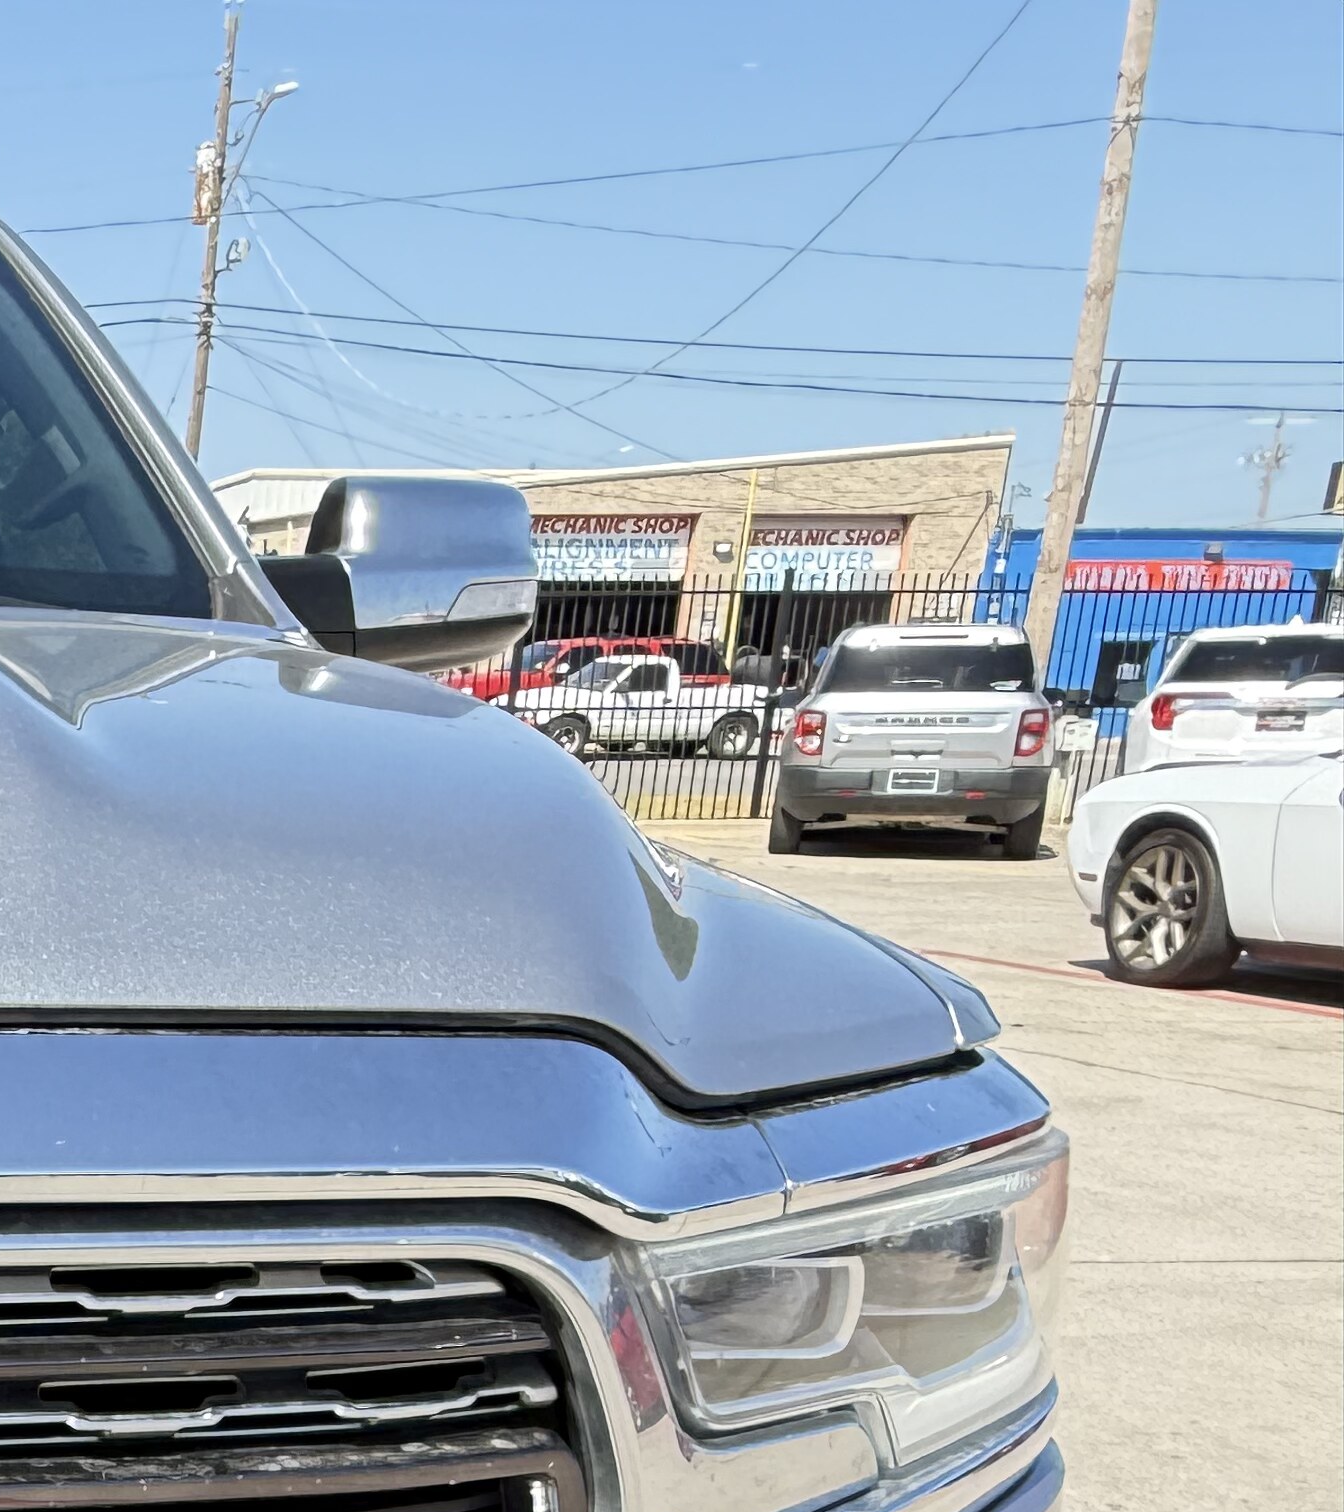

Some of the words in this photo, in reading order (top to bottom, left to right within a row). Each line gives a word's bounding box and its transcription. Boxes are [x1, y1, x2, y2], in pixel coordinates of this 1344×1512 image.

[631, 517, 690, 534] SHOP
[749, 529, 840, 547] ECHANIC
[843, 528, 901, 546] SHOP
[746, 551, 874, 570] COMPUTER
